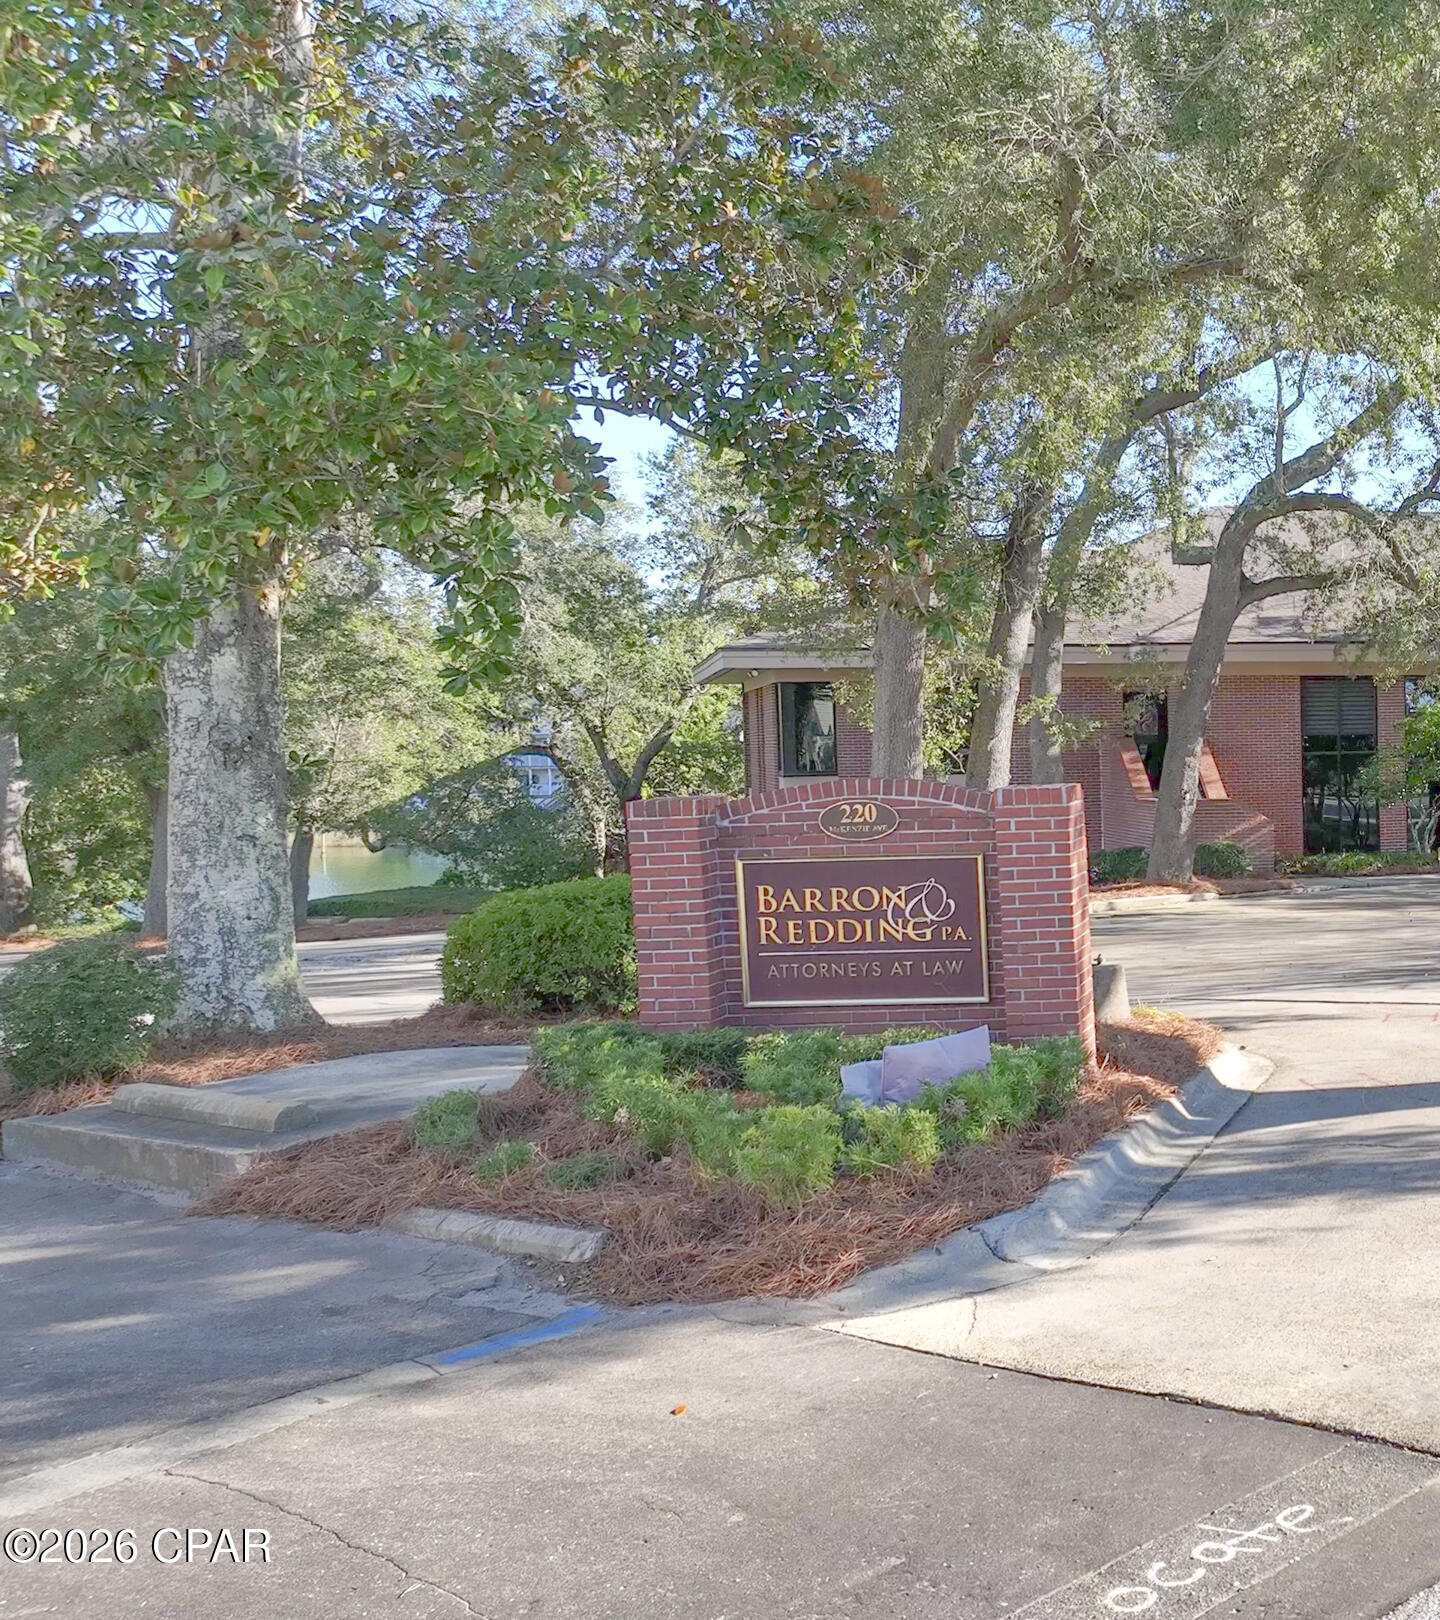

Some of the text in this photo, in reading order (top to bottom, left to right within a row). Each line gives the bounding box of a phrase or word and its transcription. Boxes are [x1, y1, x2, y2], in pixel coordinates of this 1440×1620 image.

[839, 803, 877, 823] 220
[756, 878, 956, 933] BARRON &
[757, 916, 934, 945] REDDING
[767, 960, 964, 979] ATTORNEYS AT LAW
